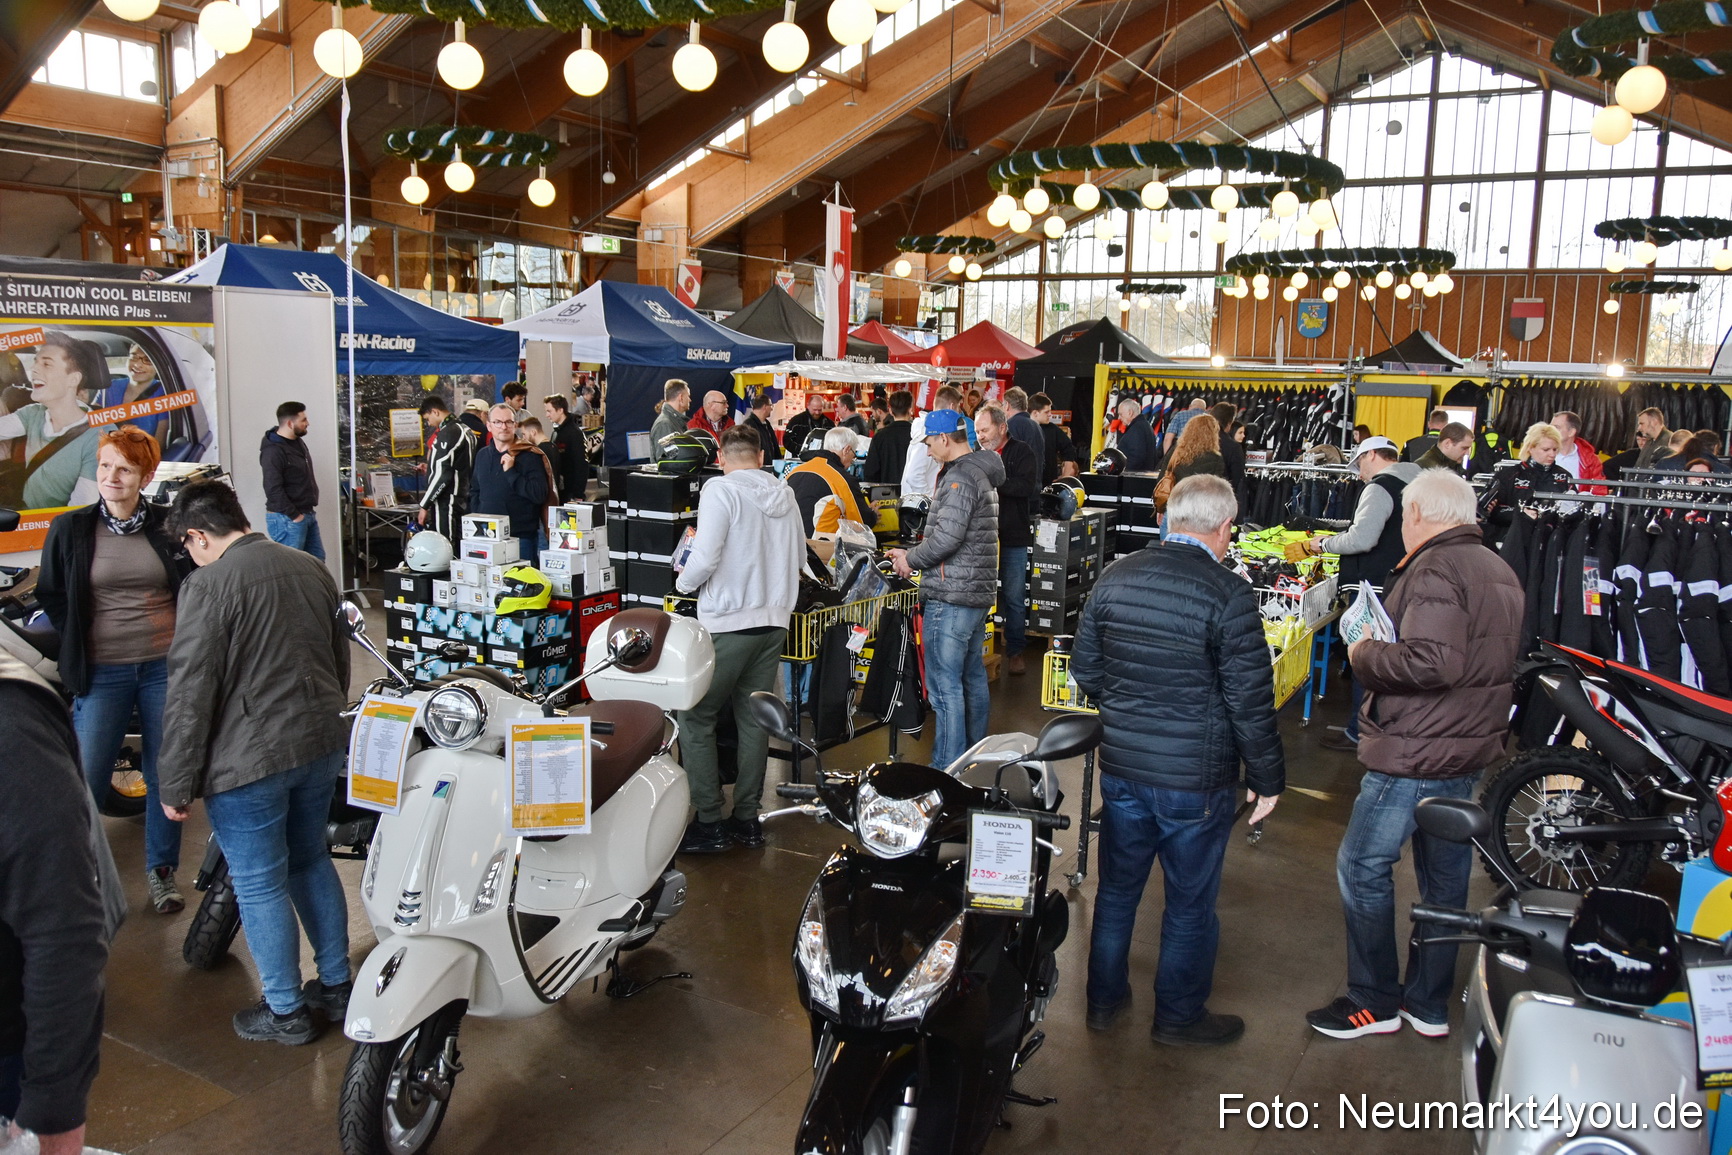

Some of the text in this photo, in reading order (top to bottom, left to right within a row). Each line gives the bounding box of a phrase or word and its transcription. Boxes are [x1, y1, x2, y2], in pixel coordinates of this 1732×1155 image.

[7, 284, 86, 299] SITUATION
[91, 287, 128, 300] COOL
[132, 289, 192, 303] BLEIBEN!
[124, 306, 151, 318] Plus
[0, 332, 43, 350] gieren
[686, 348, 731, 363] BSN-Racing
[89, 392, 195, 425] INFOS AM STAND!
[877, 499, 898, 507] COR
[15, 520, 50, 531] LEBNIS
[1034, 562, 1062, 570] DIESEL
[1032, 599, 1060, 607] DIESEL
[983, 820, 1022, 831] HONDA
[871, 882, 904, 893] HONDA
